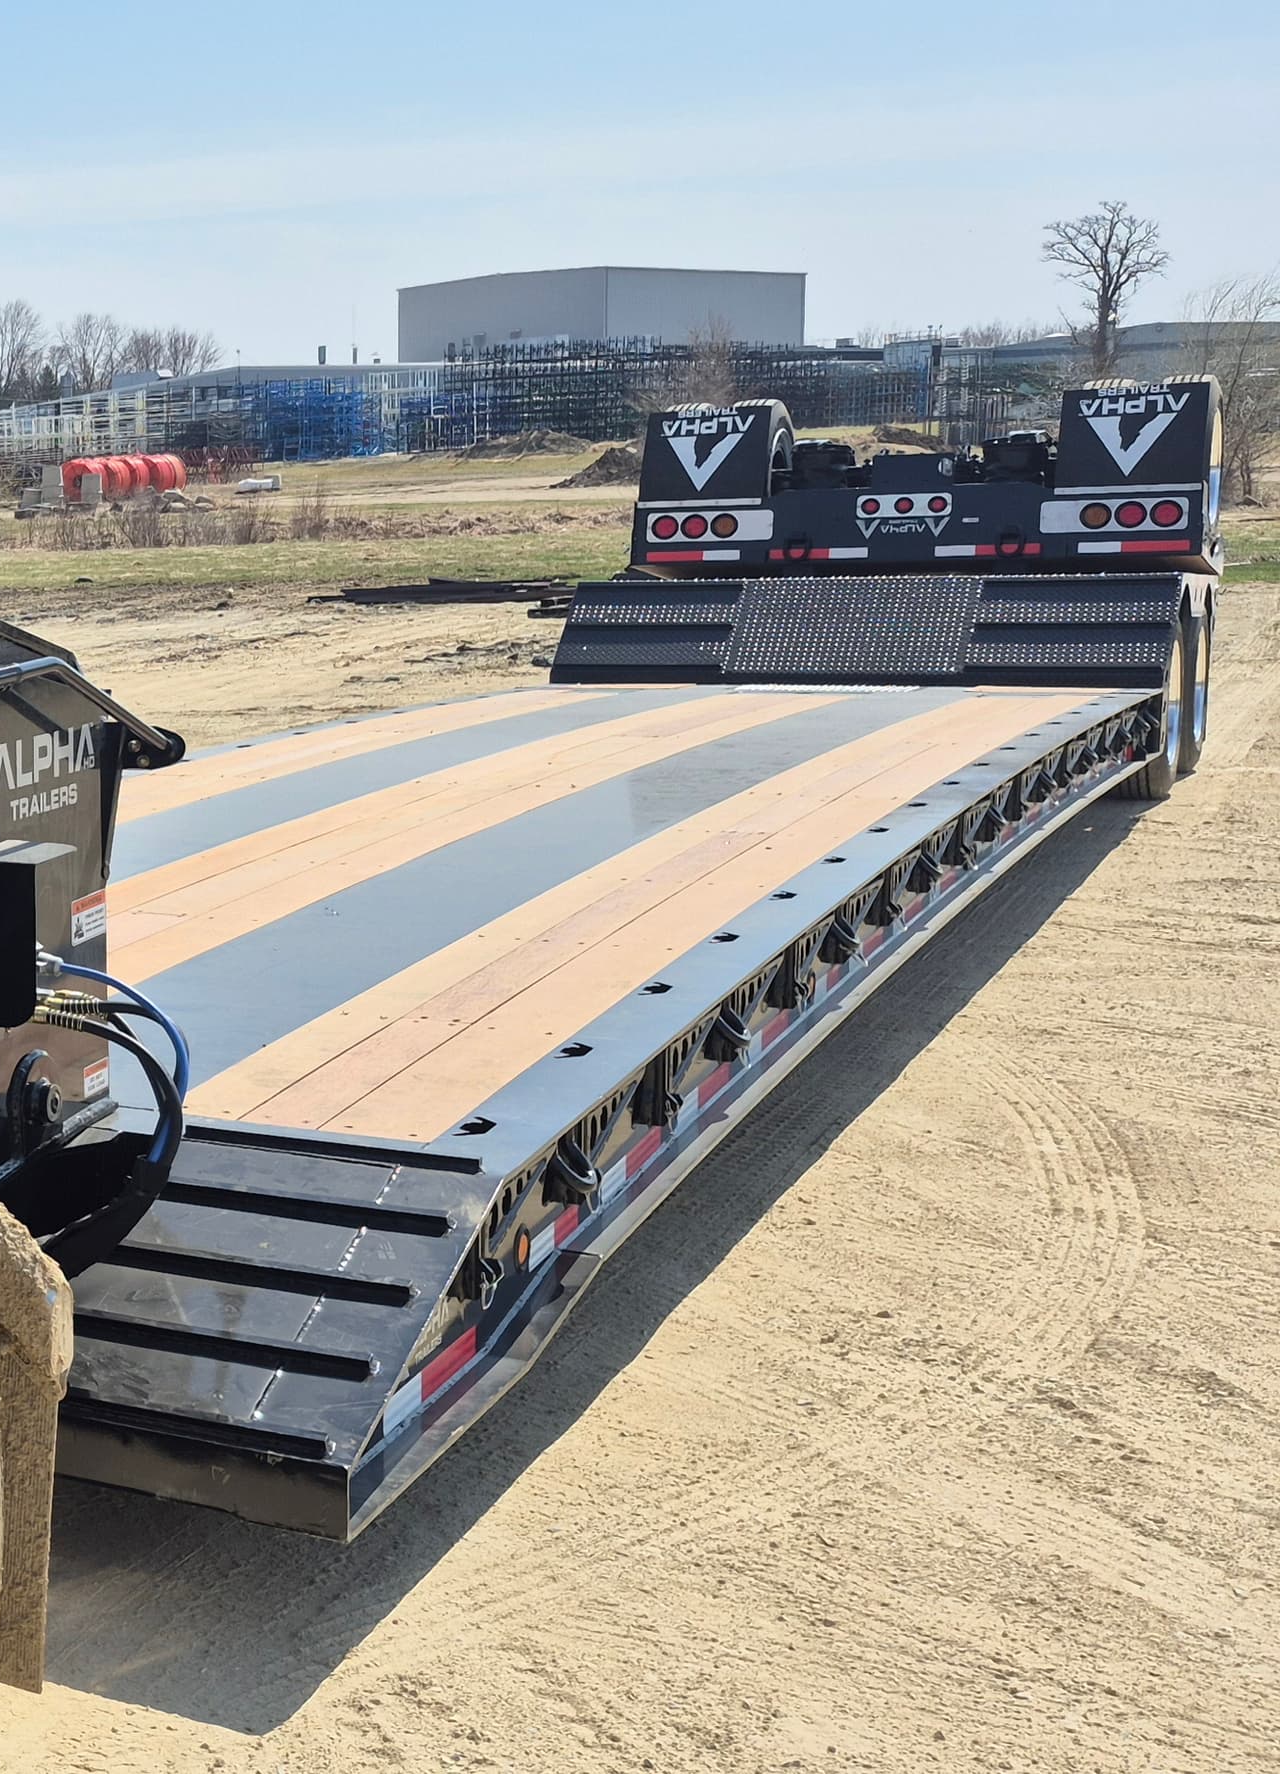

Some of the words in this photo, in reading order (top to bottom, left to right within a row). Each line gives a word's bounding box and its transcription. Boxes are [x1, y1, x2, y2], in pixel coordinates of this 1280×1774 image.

[1079, 392, 1191, 416] ALPHA
[662, 414, 755, 436] ALPHA
[880, 523, 926, 534] ALPHA
[10, 783, 78, 821] TRAILERS
